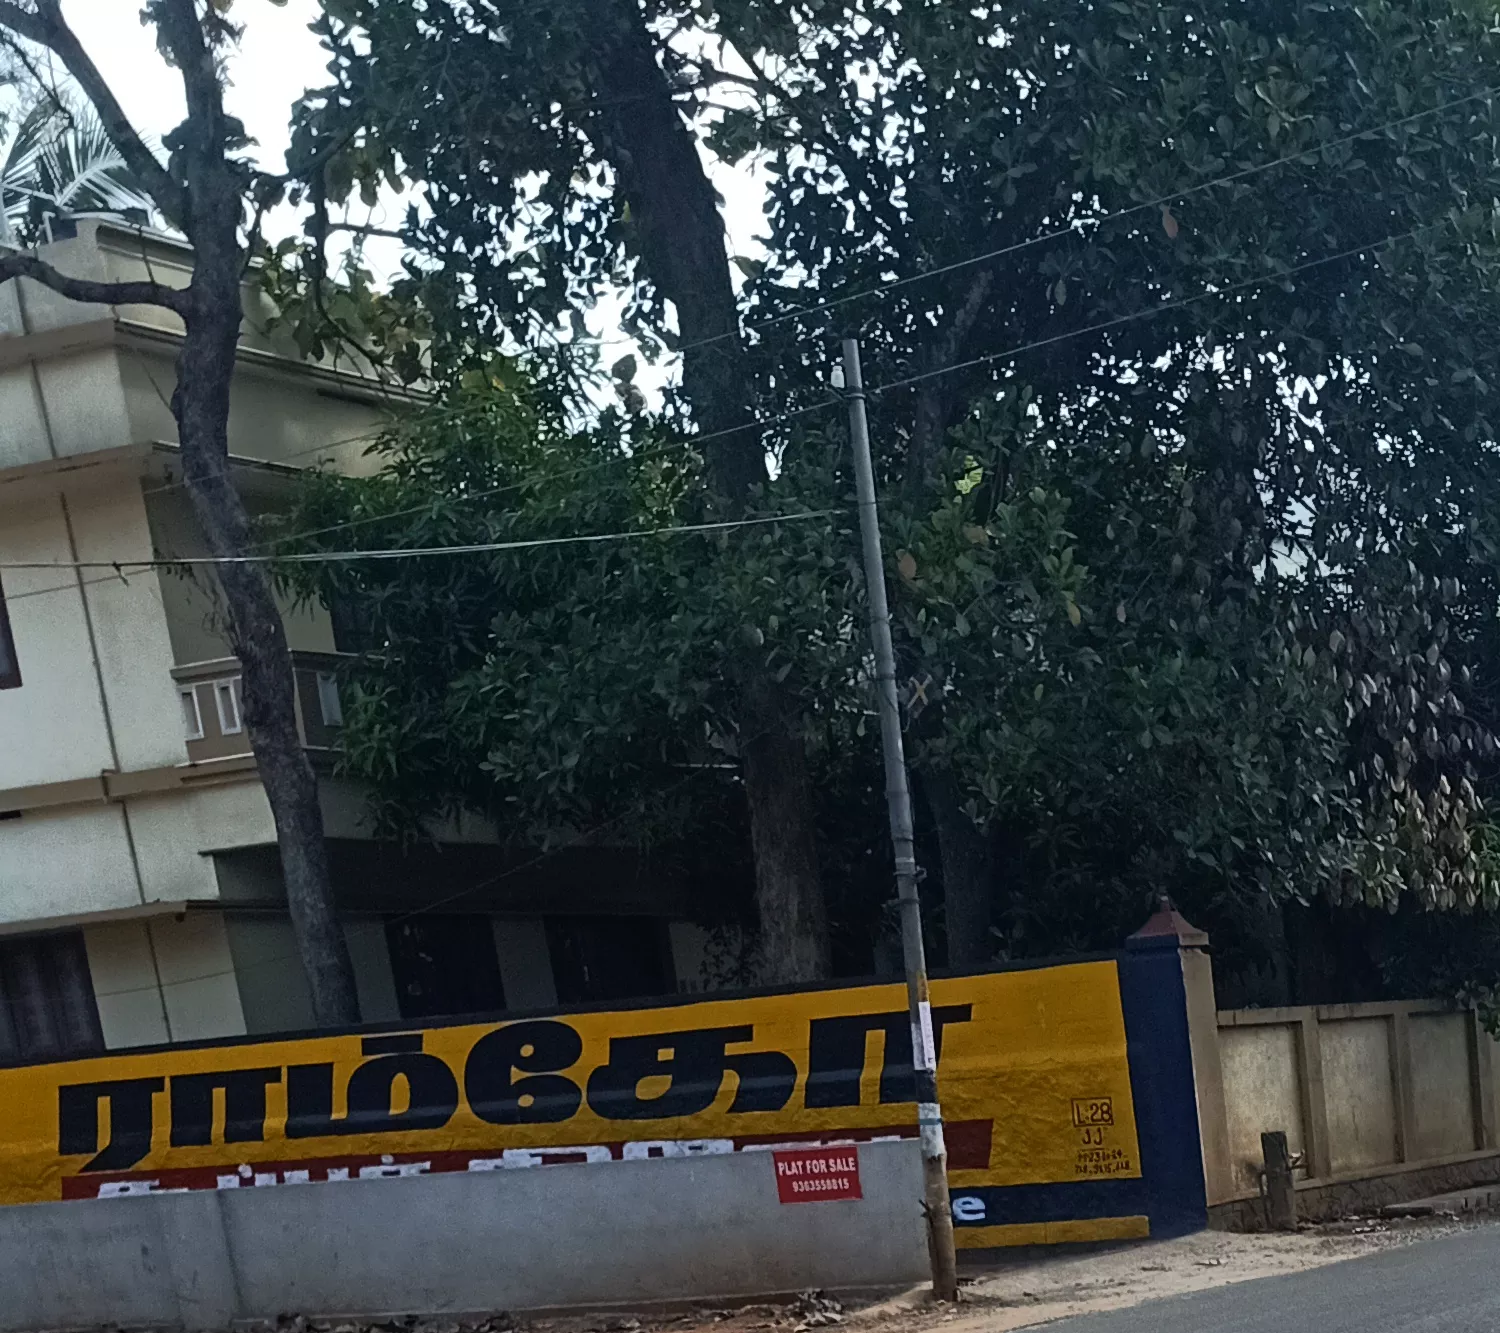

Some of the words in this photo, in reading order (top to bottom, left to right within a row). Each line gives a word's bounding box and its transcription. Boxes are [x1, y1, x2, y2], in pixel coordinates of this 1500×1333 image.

[58, 1003, 973, 1173] ராம்கோ
[777, 1160, 803, 1176] PLAT
[806, 1158, 828, 1174] FOR
[829, 1156, 856, 1173] SALE
